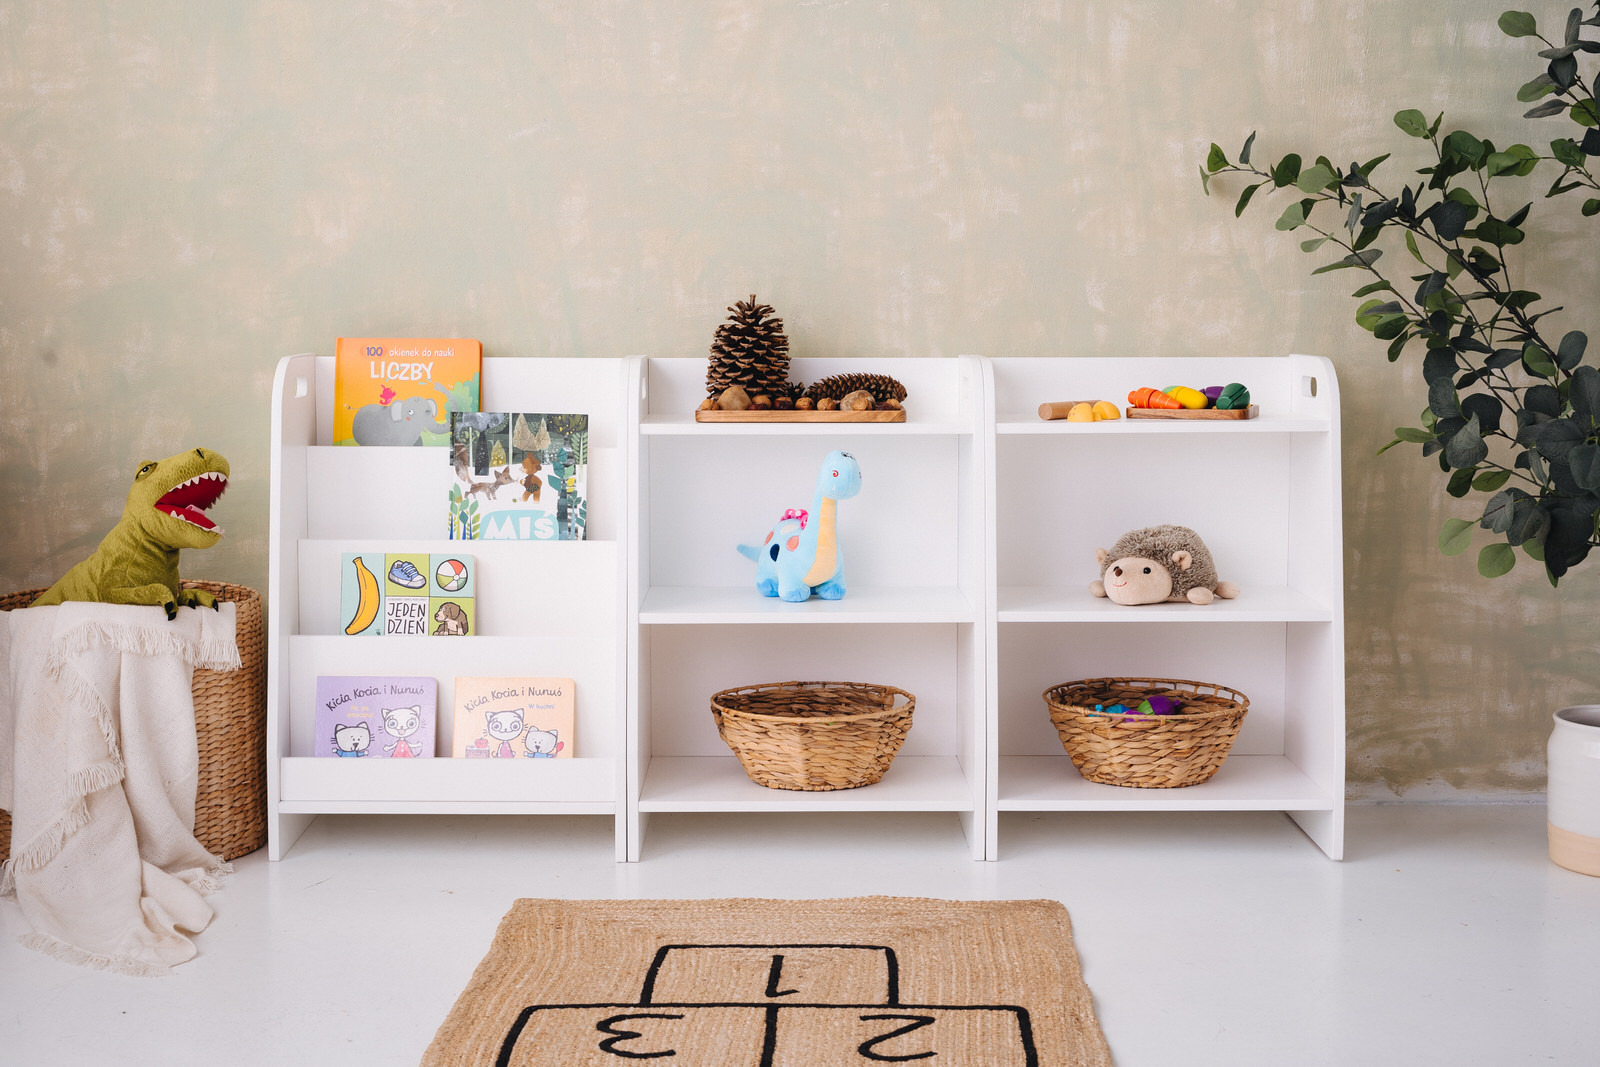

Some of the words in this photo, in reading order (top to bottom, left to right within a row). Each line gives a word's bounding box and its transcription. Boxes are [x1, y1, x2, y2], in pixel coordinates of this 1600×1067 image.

[366, 346, 383, 357] 100
[389, 347, 419, 357] okienek
[422, 347, 432, 357] do
[434, 347, 455, 357] nauki
[370, 361, 434, 381] LICZBY
[483, 510, 555, 540] MIŚ
[387, 602, 426, 618] JEDEN
[387, 617, 425, 634] DZIEŃ
[325, 693, 352, 712] Kicia
[353, 685, 381, 699] Kocia
[383, 685, 387, 695] i
[390, 685, 425, 695] Nunuś
[464, 695, 490, 713] Kicia
[491, 687, 519, 701] Kocia
[521, 686, 525, 696] i
[528, 686, 562, 697] Nunuś
[765, 955, 800, 997] 1
[596, 1013, 685, 1059] 3
[858, 1014, 938, 1061] 2
